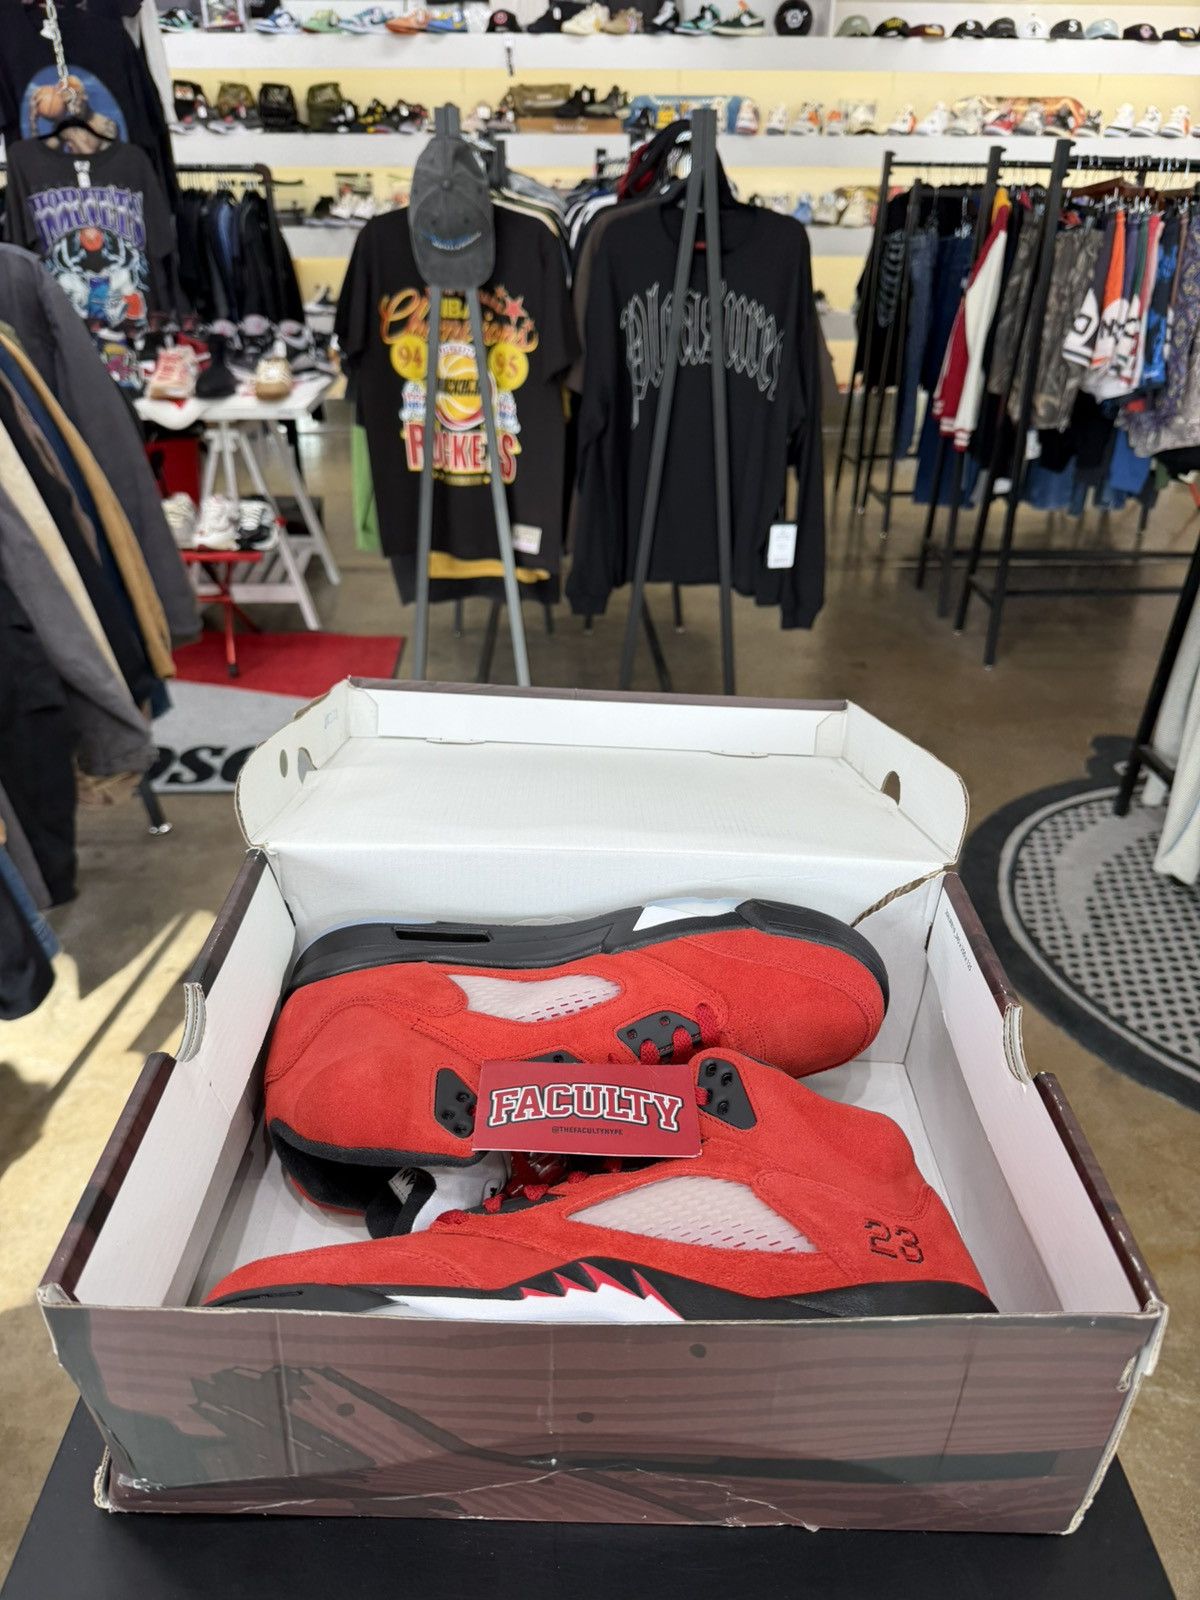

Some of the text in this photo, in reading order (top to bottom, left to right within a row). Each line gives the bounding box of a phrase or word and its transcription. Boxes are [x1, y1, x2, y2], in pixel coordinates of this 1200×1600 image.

[400, 346, 422, 369] 94
[495, 353, 519, 376] 95
[403, 421, 519, 485] ROCKES
[488, 1083, 684, 1132] FACULTY
[864, 1218, 924, 1264] 23
